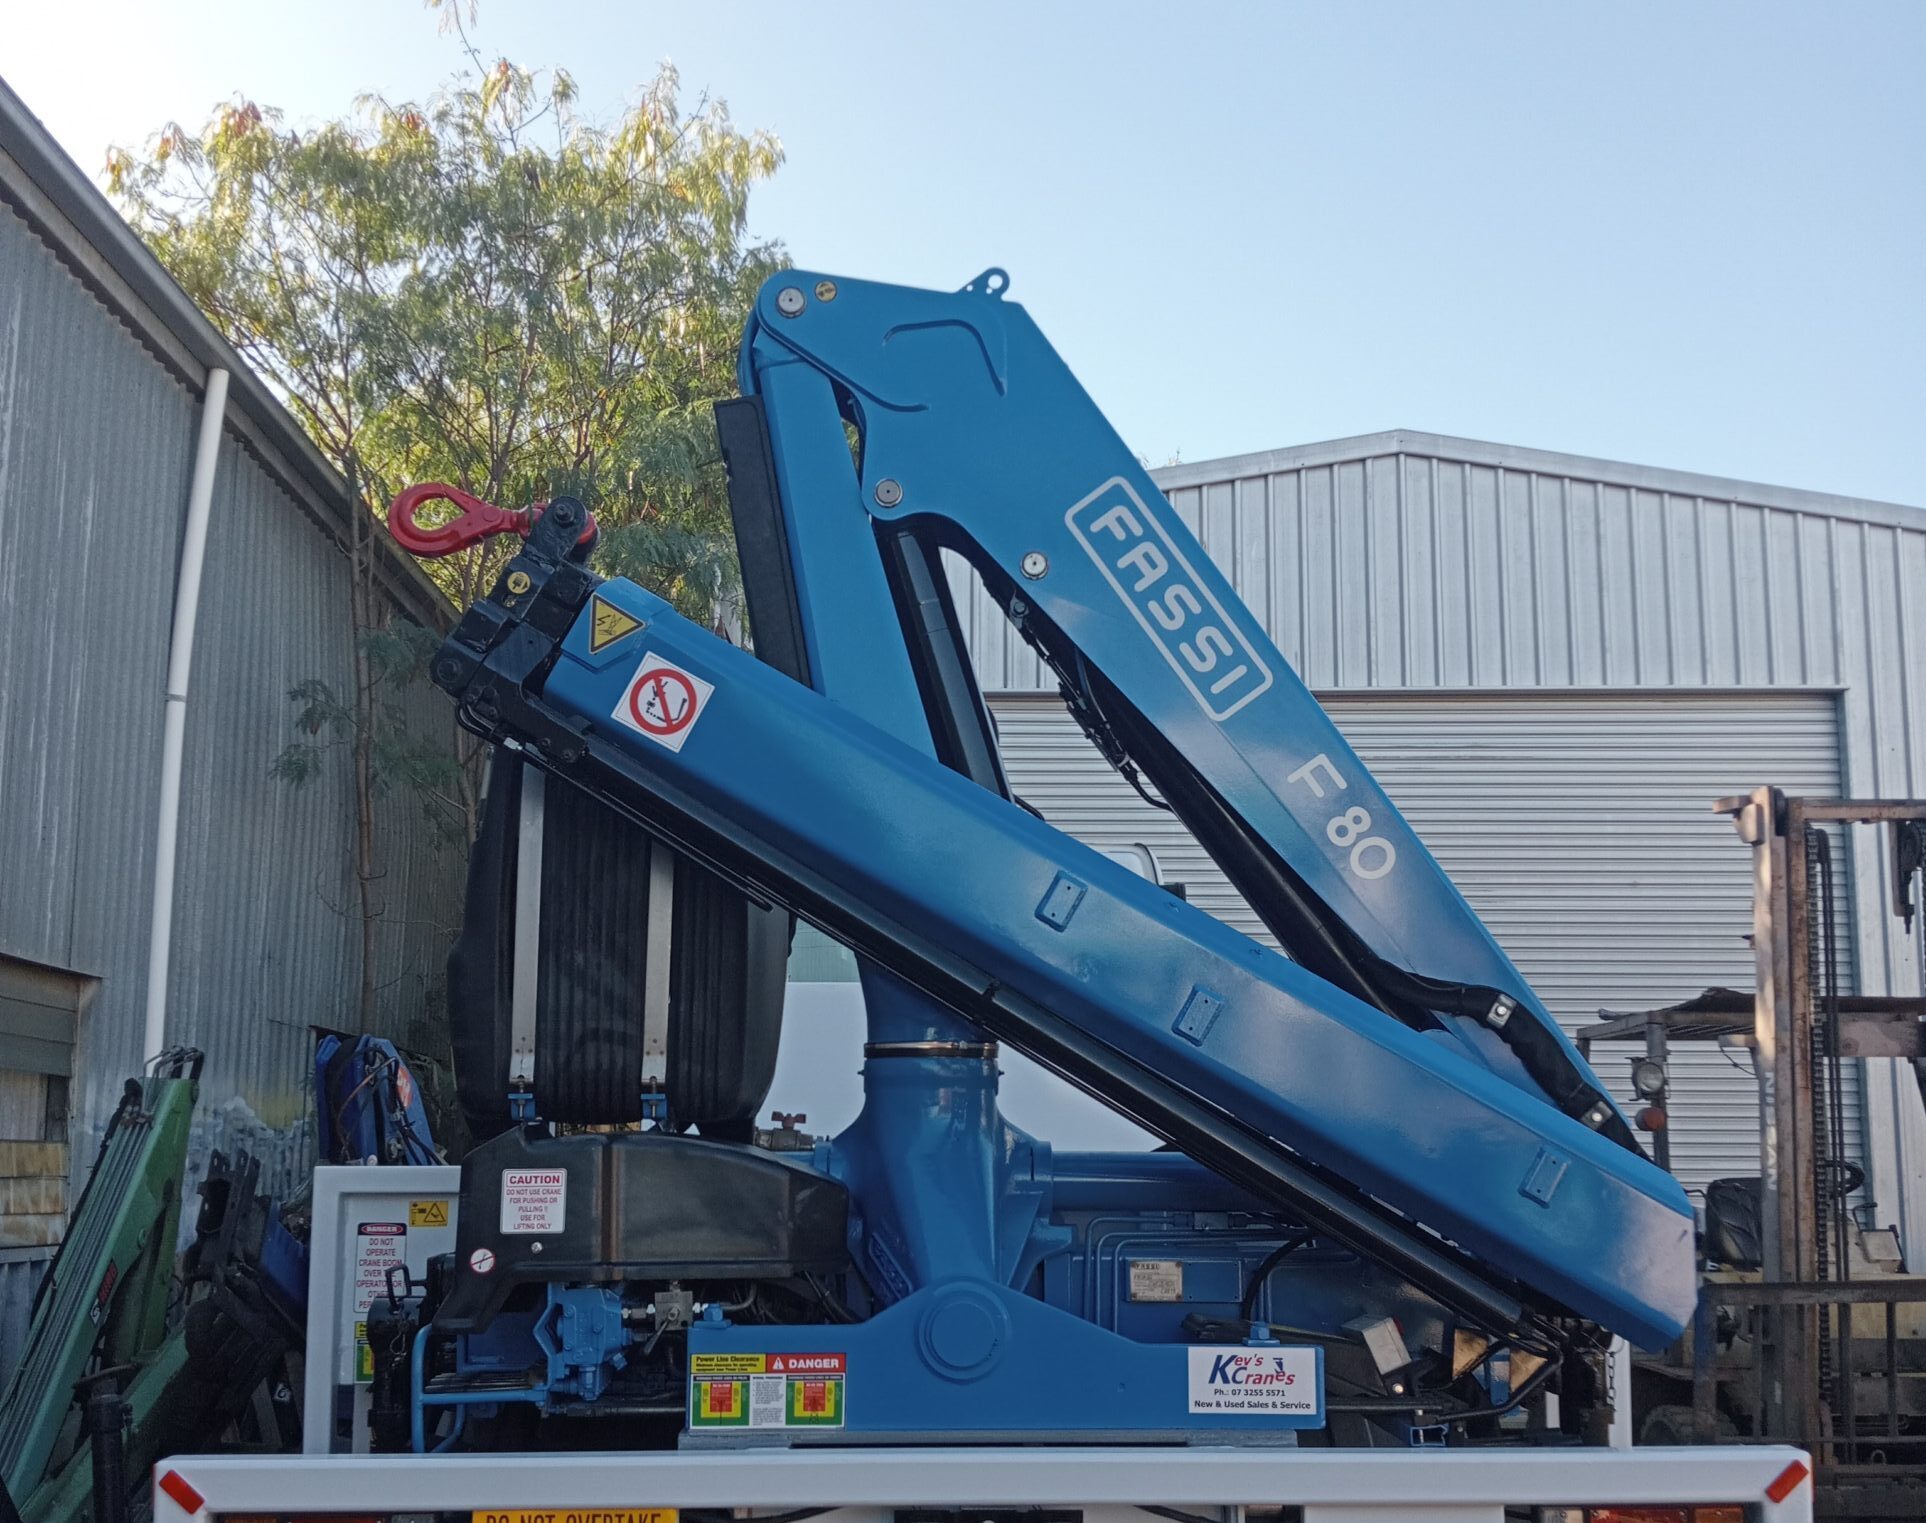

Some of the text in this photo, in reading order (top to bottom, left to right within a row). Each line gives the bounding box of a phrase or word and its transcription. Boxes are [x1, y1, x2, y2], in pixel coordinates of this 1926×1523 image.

[1090, 505, 1248, 694] FASSI
[1287, 753, 1396, 880] F 80
[1764, 1072, 1777, 1190] NISSAN
[509, 1175, 560, 1184] CAUTION
[366, 1248, 396, 1256] OPERATE
[788, 1359, 839, 1369] DANGER
[1208, 1354, 1263, 1384] Kev's
[1231, 1367, 1296, 1385] Cranes
[1247, 1401, 1269, 1409] Sales
[1271, 1401, 1278, 1409] &
